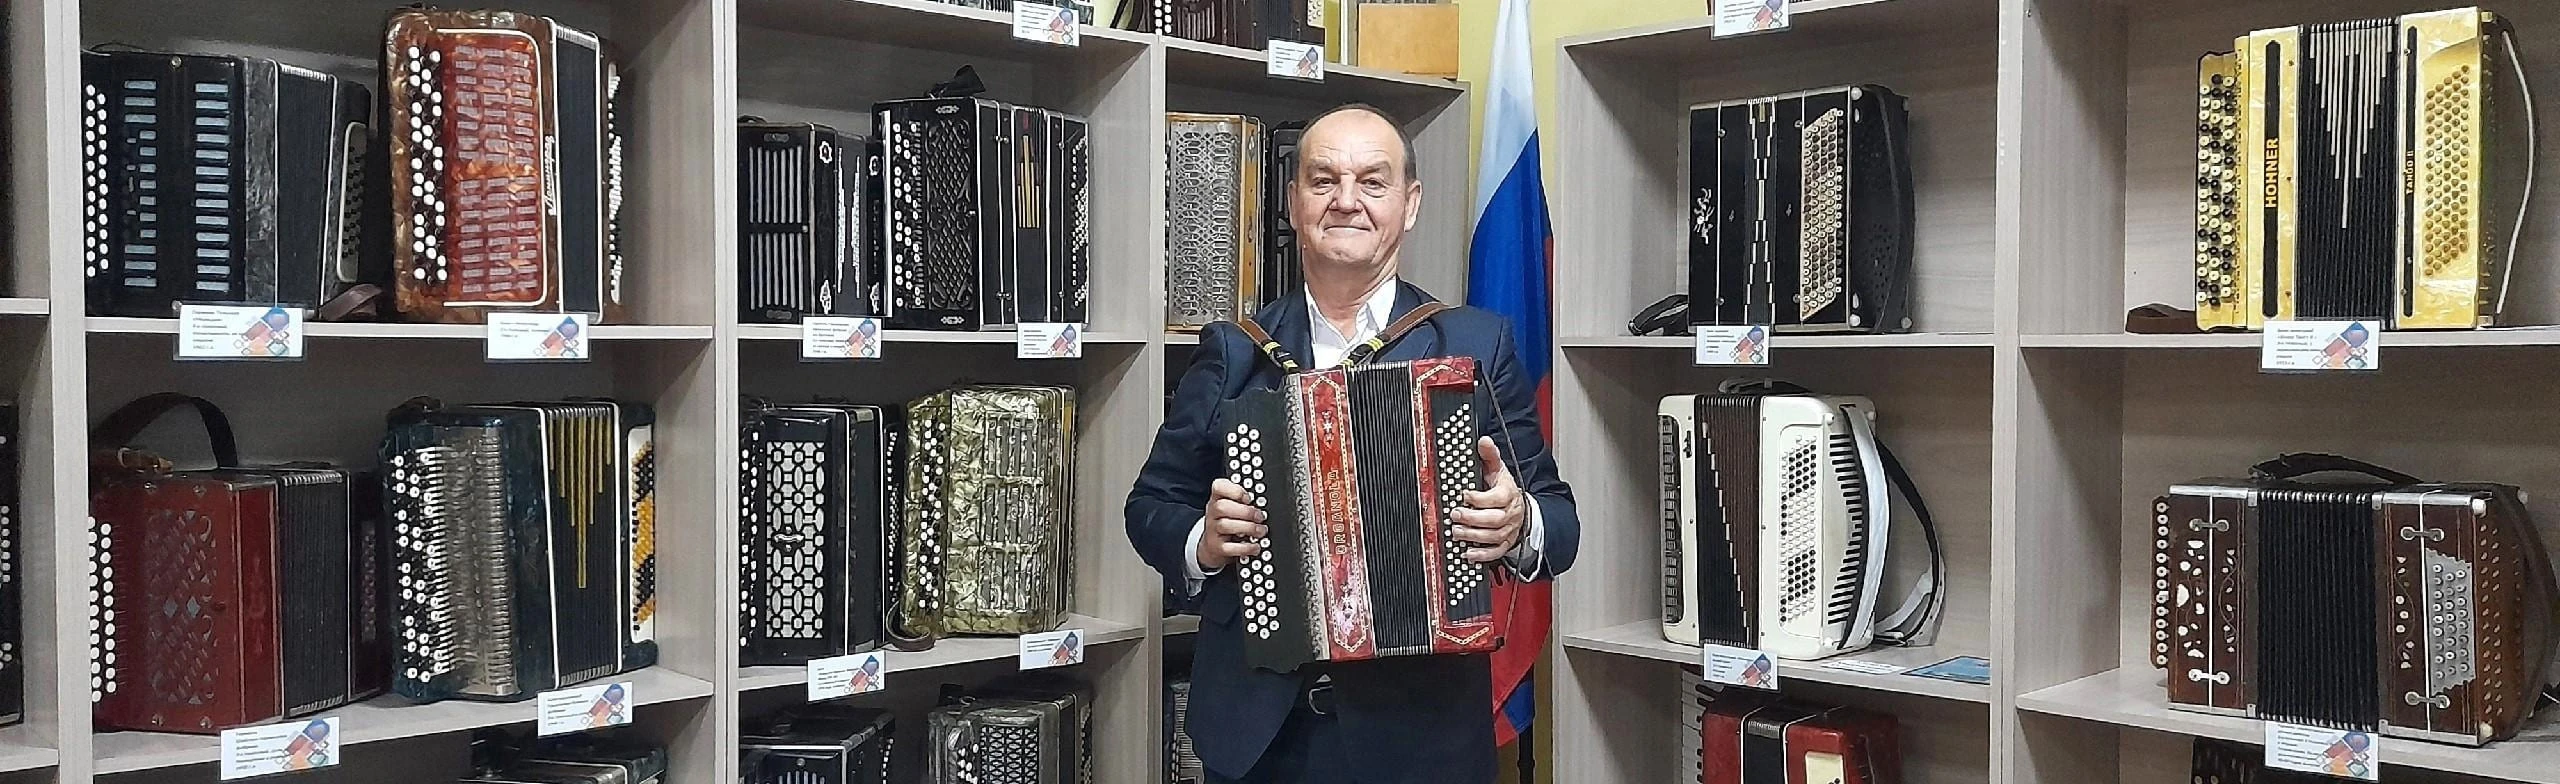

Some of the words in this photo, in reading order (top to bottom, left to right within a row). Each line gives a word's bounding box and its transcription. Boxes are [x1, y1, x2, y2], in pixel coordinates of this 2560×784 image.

[2264, 137, 2279, 208] HOHNER
[2405, 160, 2414, 195] TANGO
[1327, 469, 1347, 555] ORGANOLA
